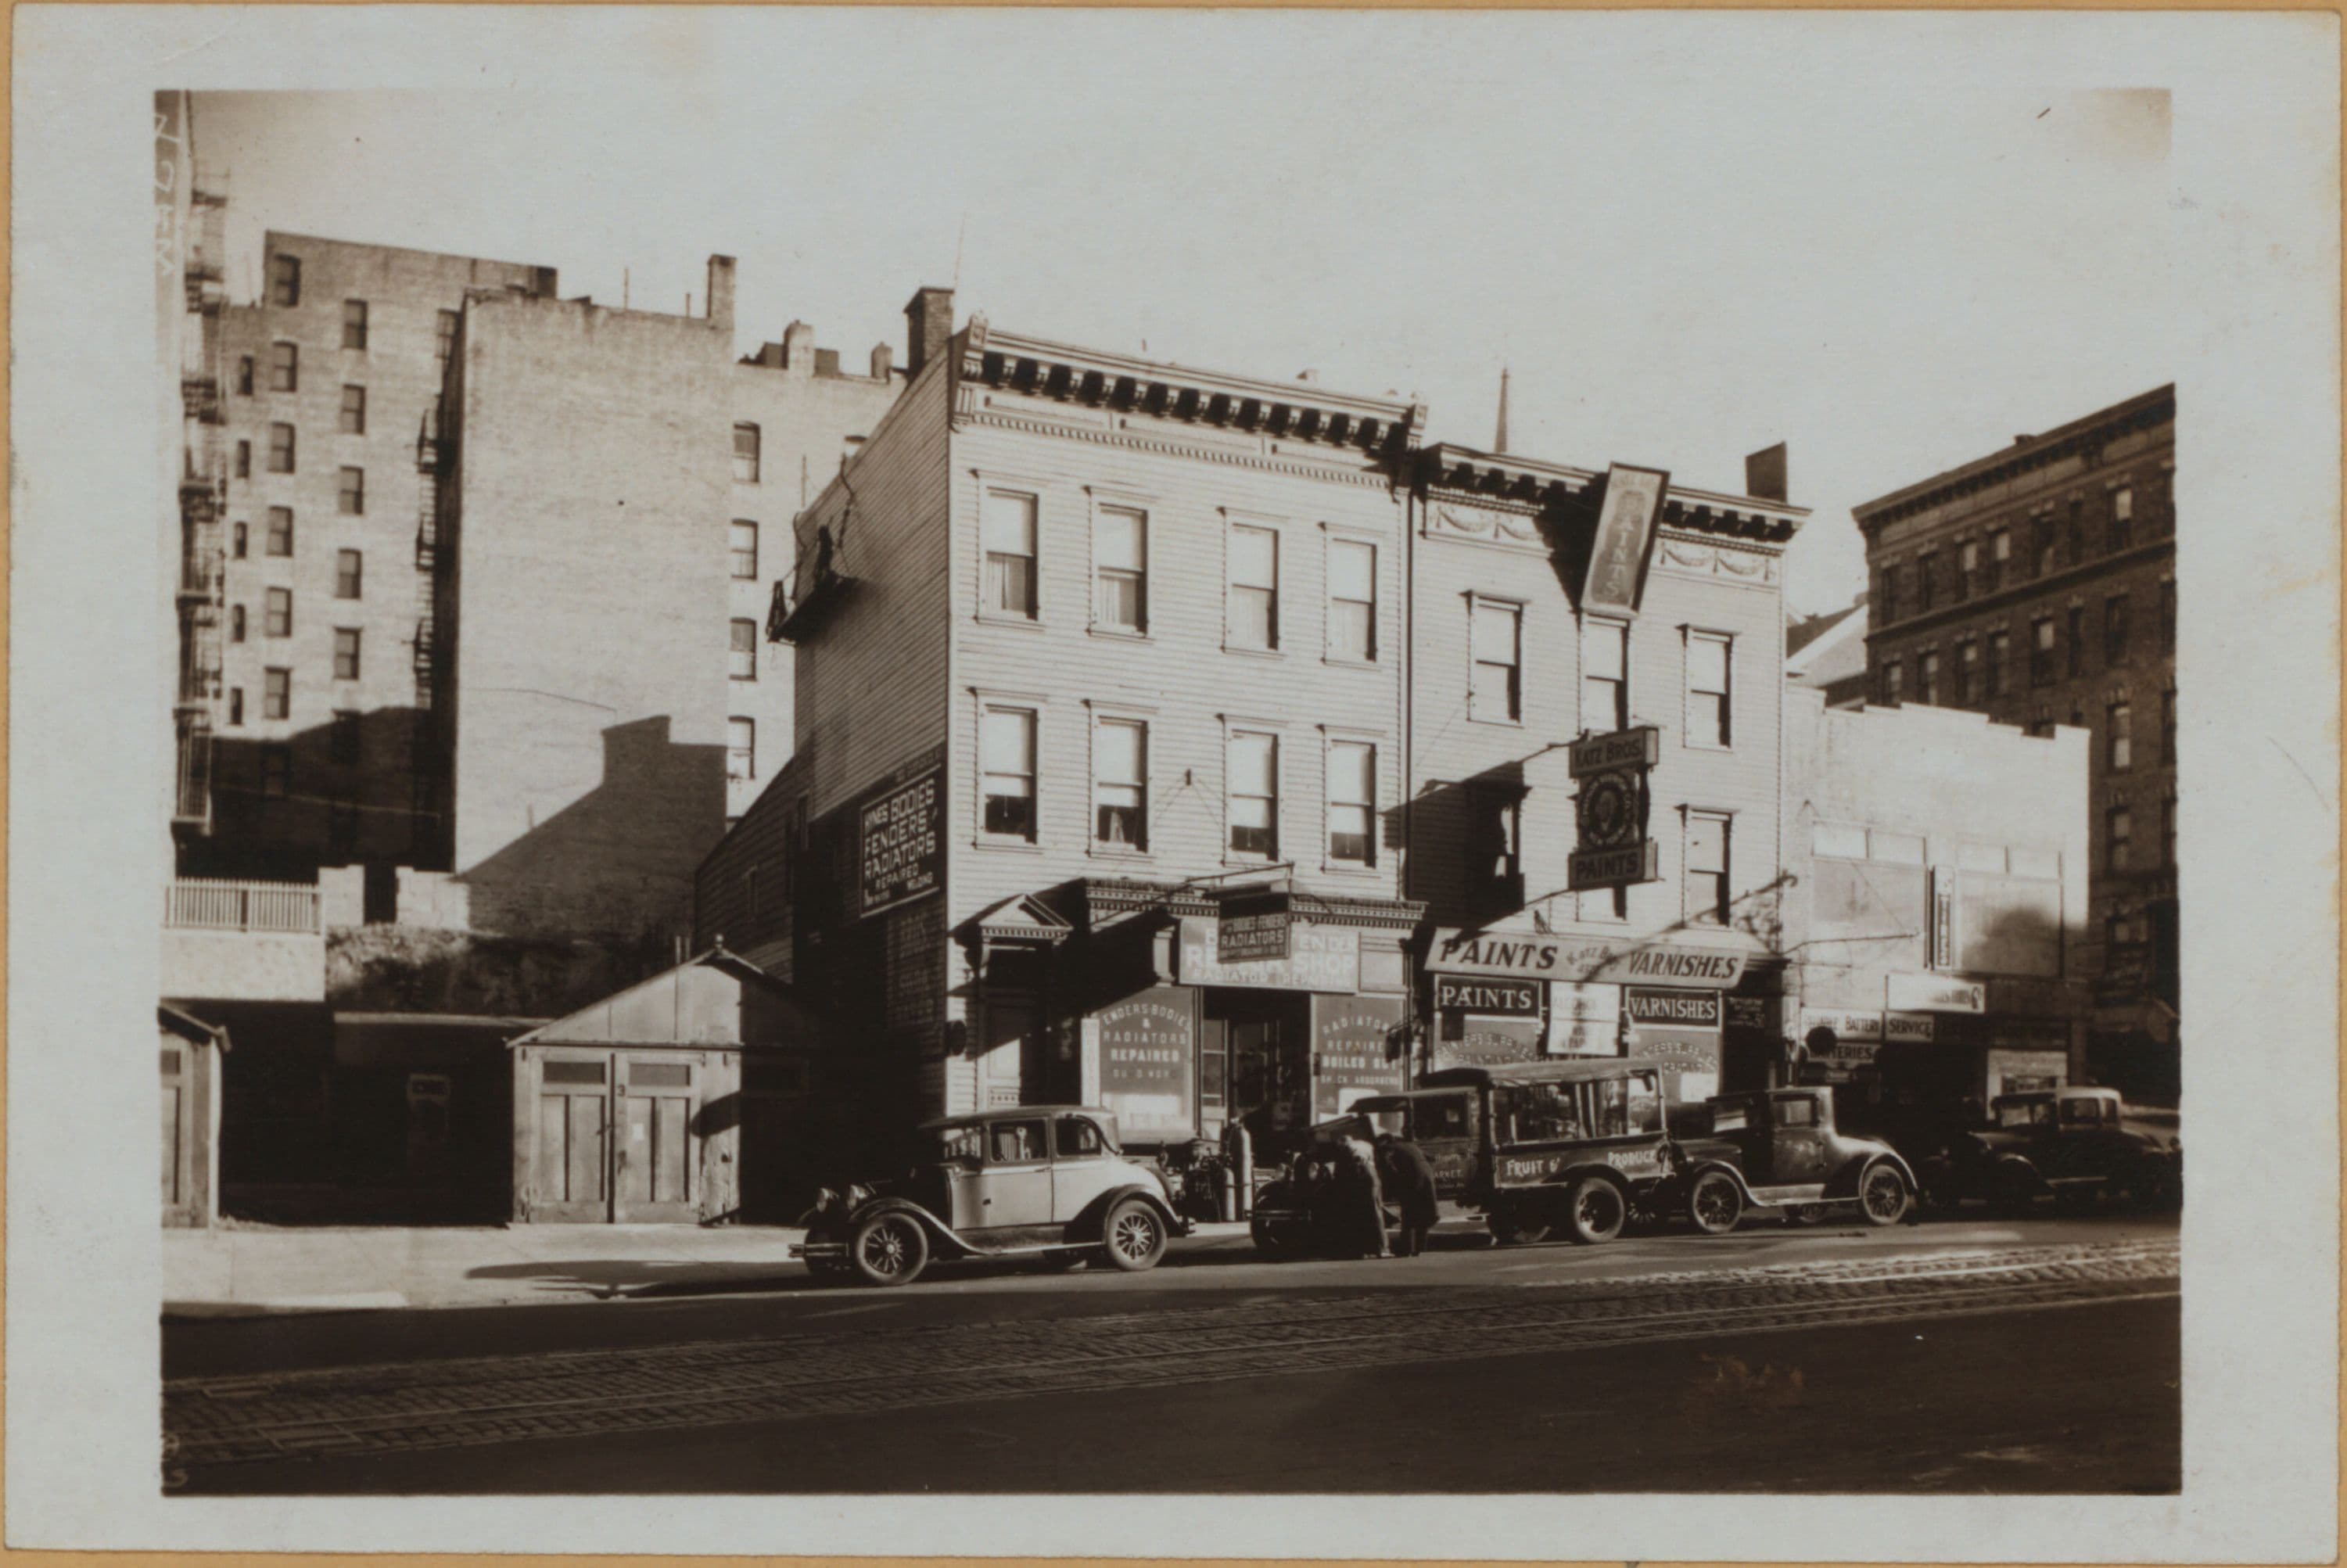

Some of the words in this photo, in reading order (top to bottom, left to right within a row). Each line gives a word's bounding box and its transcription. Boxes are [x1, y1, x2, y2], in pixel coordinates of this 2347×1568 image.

[890, 778, 935, 823] BODIES
[864, 809, 928, 859] FENDERS
[864, 831, 935, 881] RADIATORS
[1576, 852, 1638, 881] PAINTS
[875, 863, 919, 890] REPAIRED
[1221, 929, 1284, 949] RADIATORS
[1294, 951, 1355, 974] SHOP
[1438, 938, 1559, 970] PAINTS
[1627, 949, 1740, 978] VARNISHES
[1441, 985, 1532, 1010] PAINTS
[1628, 996, 1717, 1020] VARNISHES
[1143, 1017, 1151, 1028] &
[1889, 1018, 1932, 1036] SERVICE
[1103, 1031, 1186, 1045] RADIATORS
[1327, 1039, 1383, 1053] REPAIRE
[1110, 1048, 1179, 1062] REPAIRED
[617, 1082, 626, 1097] 3
[1506, 1159, 1543, 1177] FRUIT
